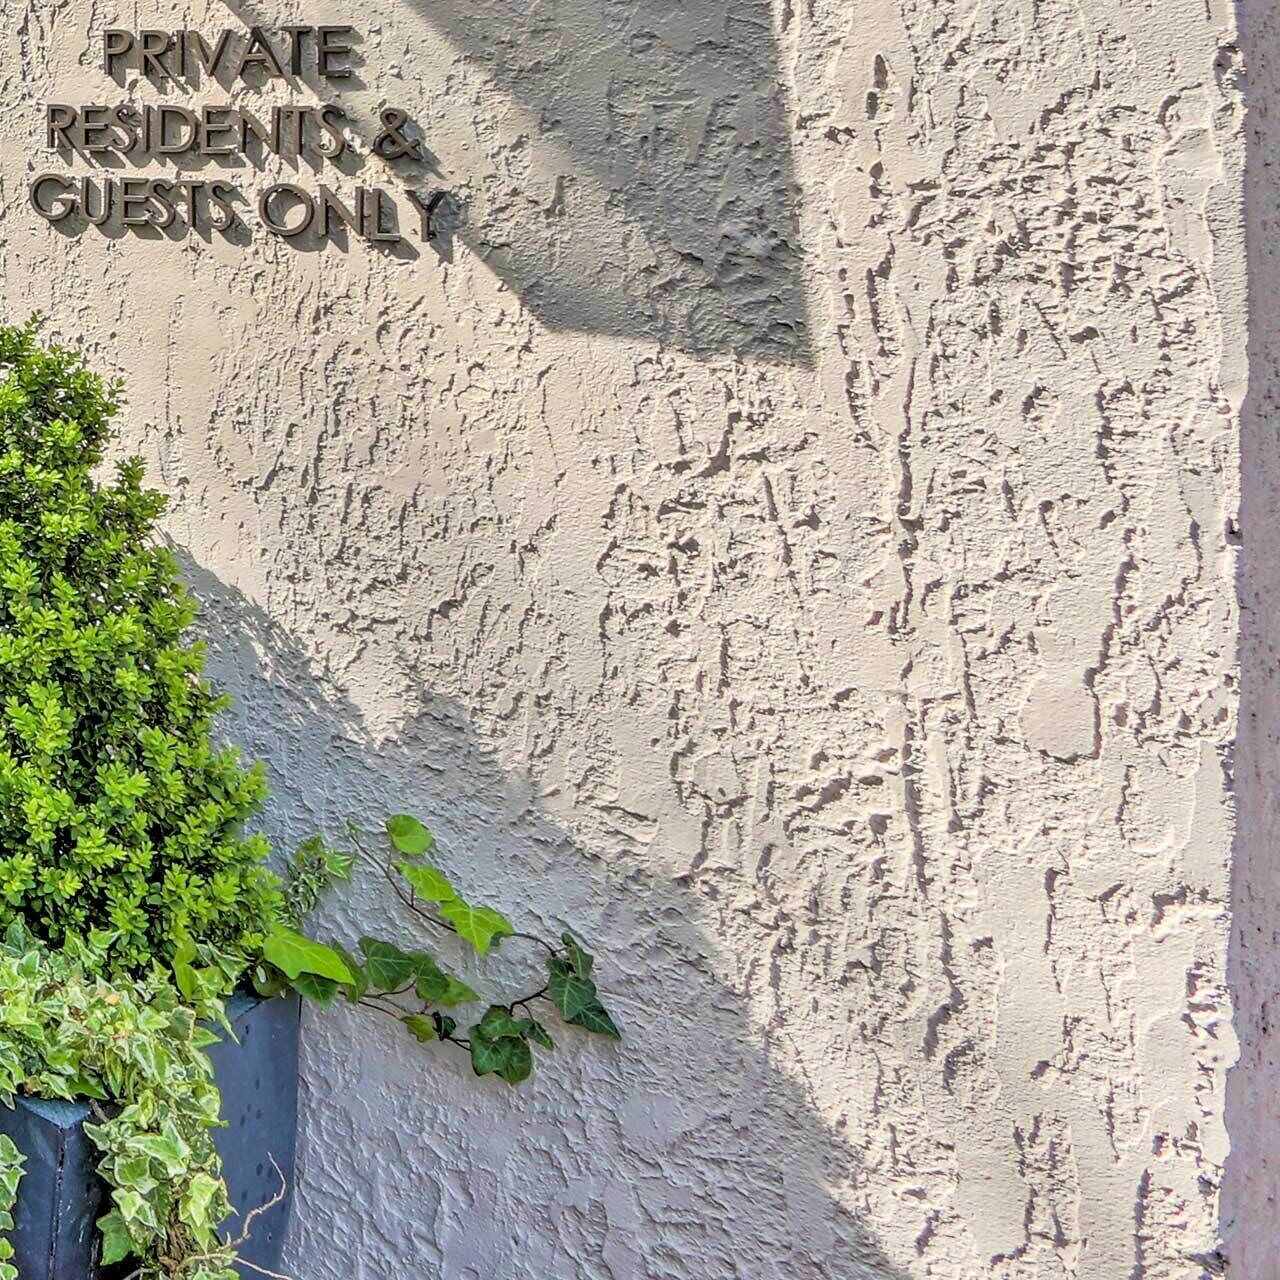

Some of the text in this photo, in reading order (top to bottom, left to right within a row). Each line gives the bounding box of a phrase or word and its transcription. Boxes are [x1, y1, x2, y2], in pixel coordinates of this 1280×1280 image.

[104, 25, 353, 77] PRIVATE
[46, 104, 422, 160] RESIDENTS &
[29, 173, 446, 243] GUESTS ONLY
